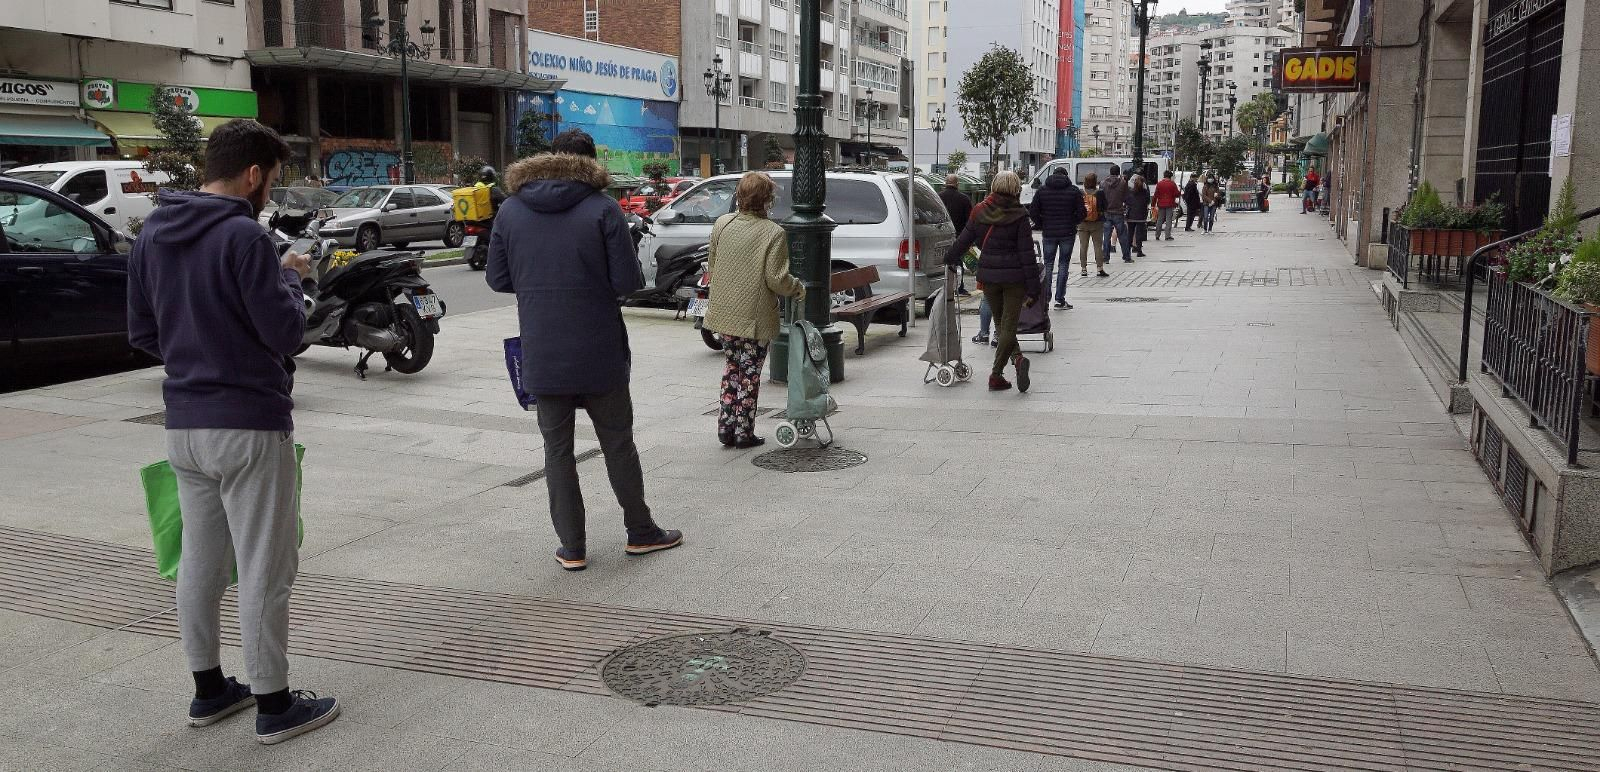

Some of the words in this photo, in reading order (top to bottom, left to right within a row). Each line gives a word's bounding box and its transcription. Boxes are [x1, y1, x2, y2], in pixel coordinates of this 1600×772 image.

[569, 55, 593, 74] NIÑO
[594, 60, 618, 78] JESÚS
[619, 65, 630, 80] DE
[631, 66, 658, 84] PRAGA
[1285, 56, 1356, 81] GADIS
